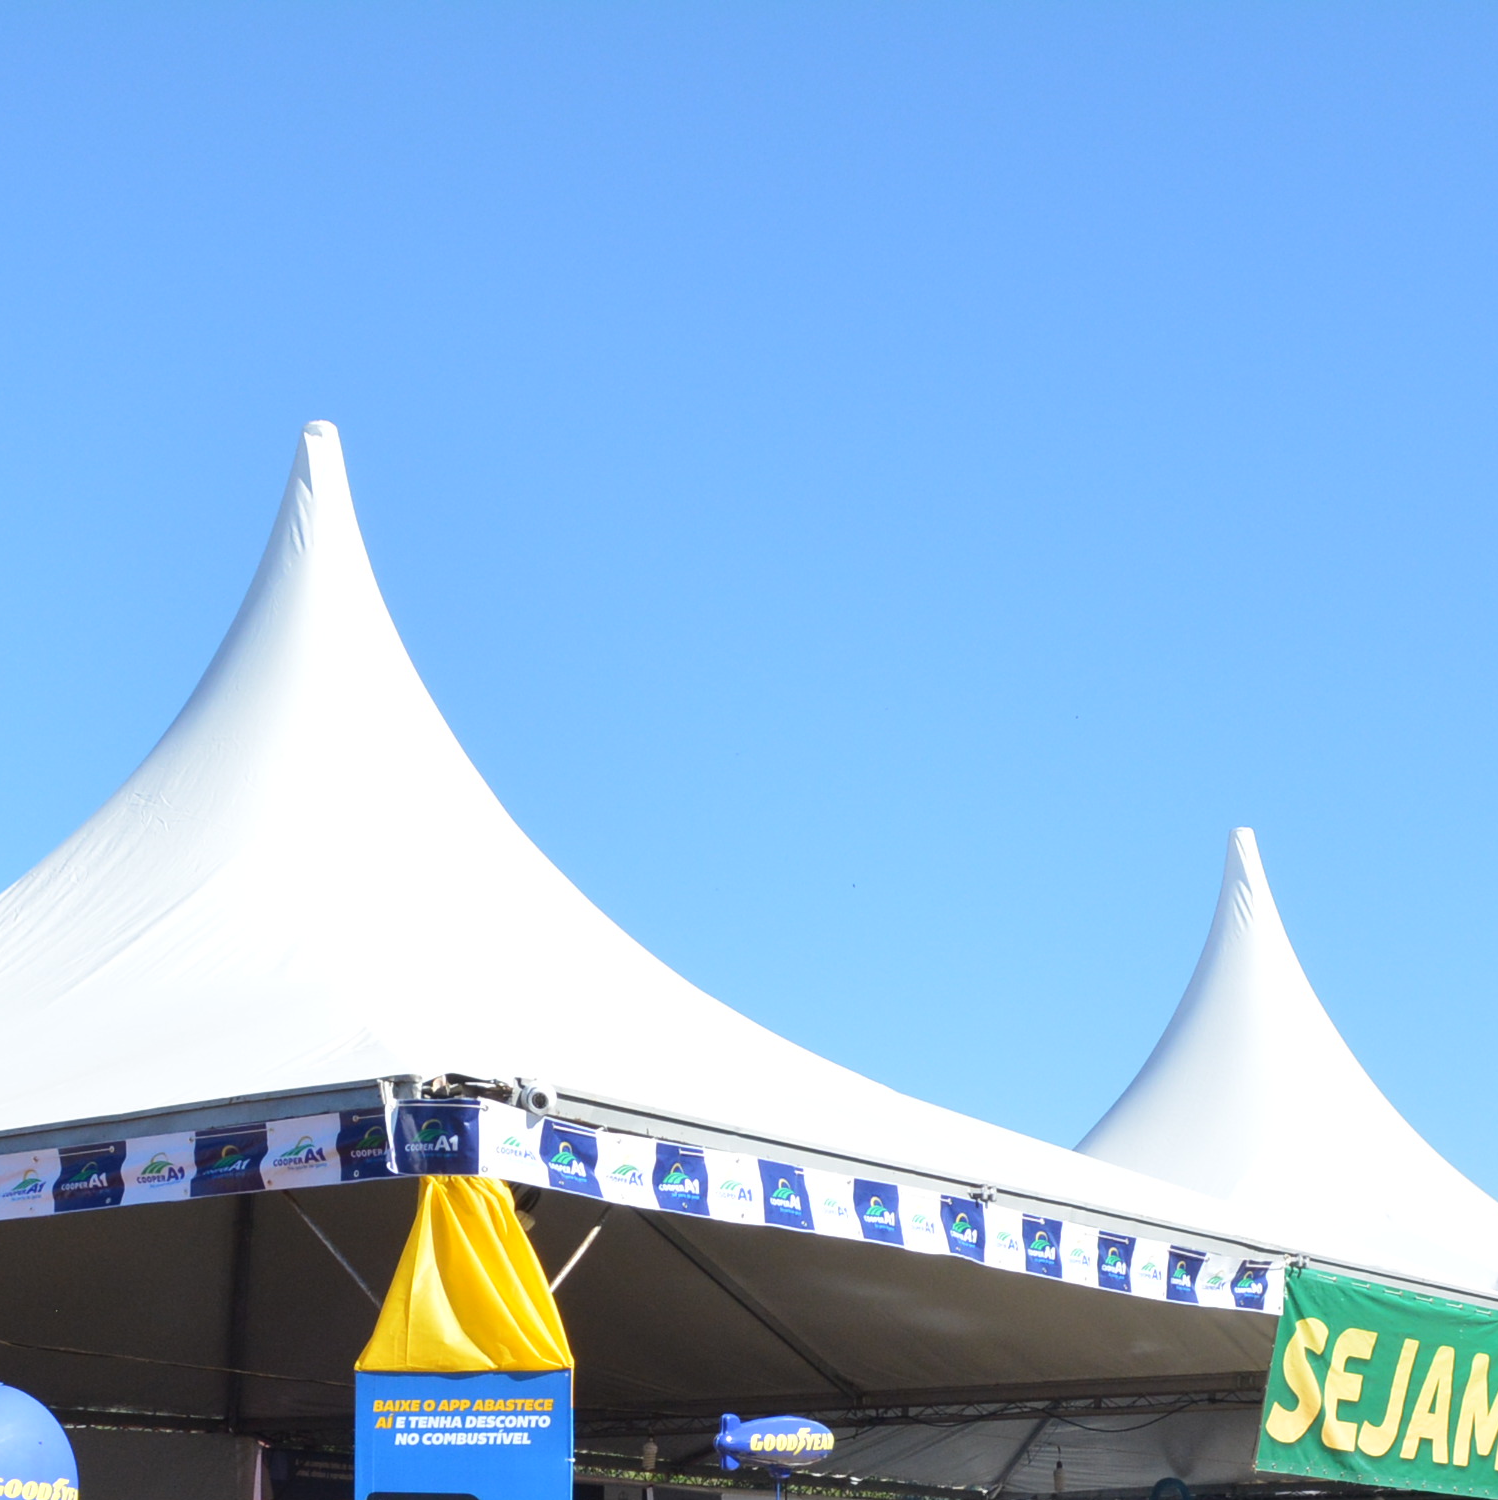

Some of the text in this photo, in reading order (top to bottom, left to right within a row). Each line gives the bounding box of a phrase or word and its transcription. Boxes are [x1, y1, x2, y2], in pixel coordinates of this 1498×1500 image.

[373, 1398, 554, 1412] BAIXE O APP ABASTECE
[375, 1413, 551, 1429] AÍ E TENHA DESCONTO
[394, 1429, 532, 1445] NO COMBUSTÍVEL
[750, 1427, 836, 1456] GOODYEAR
